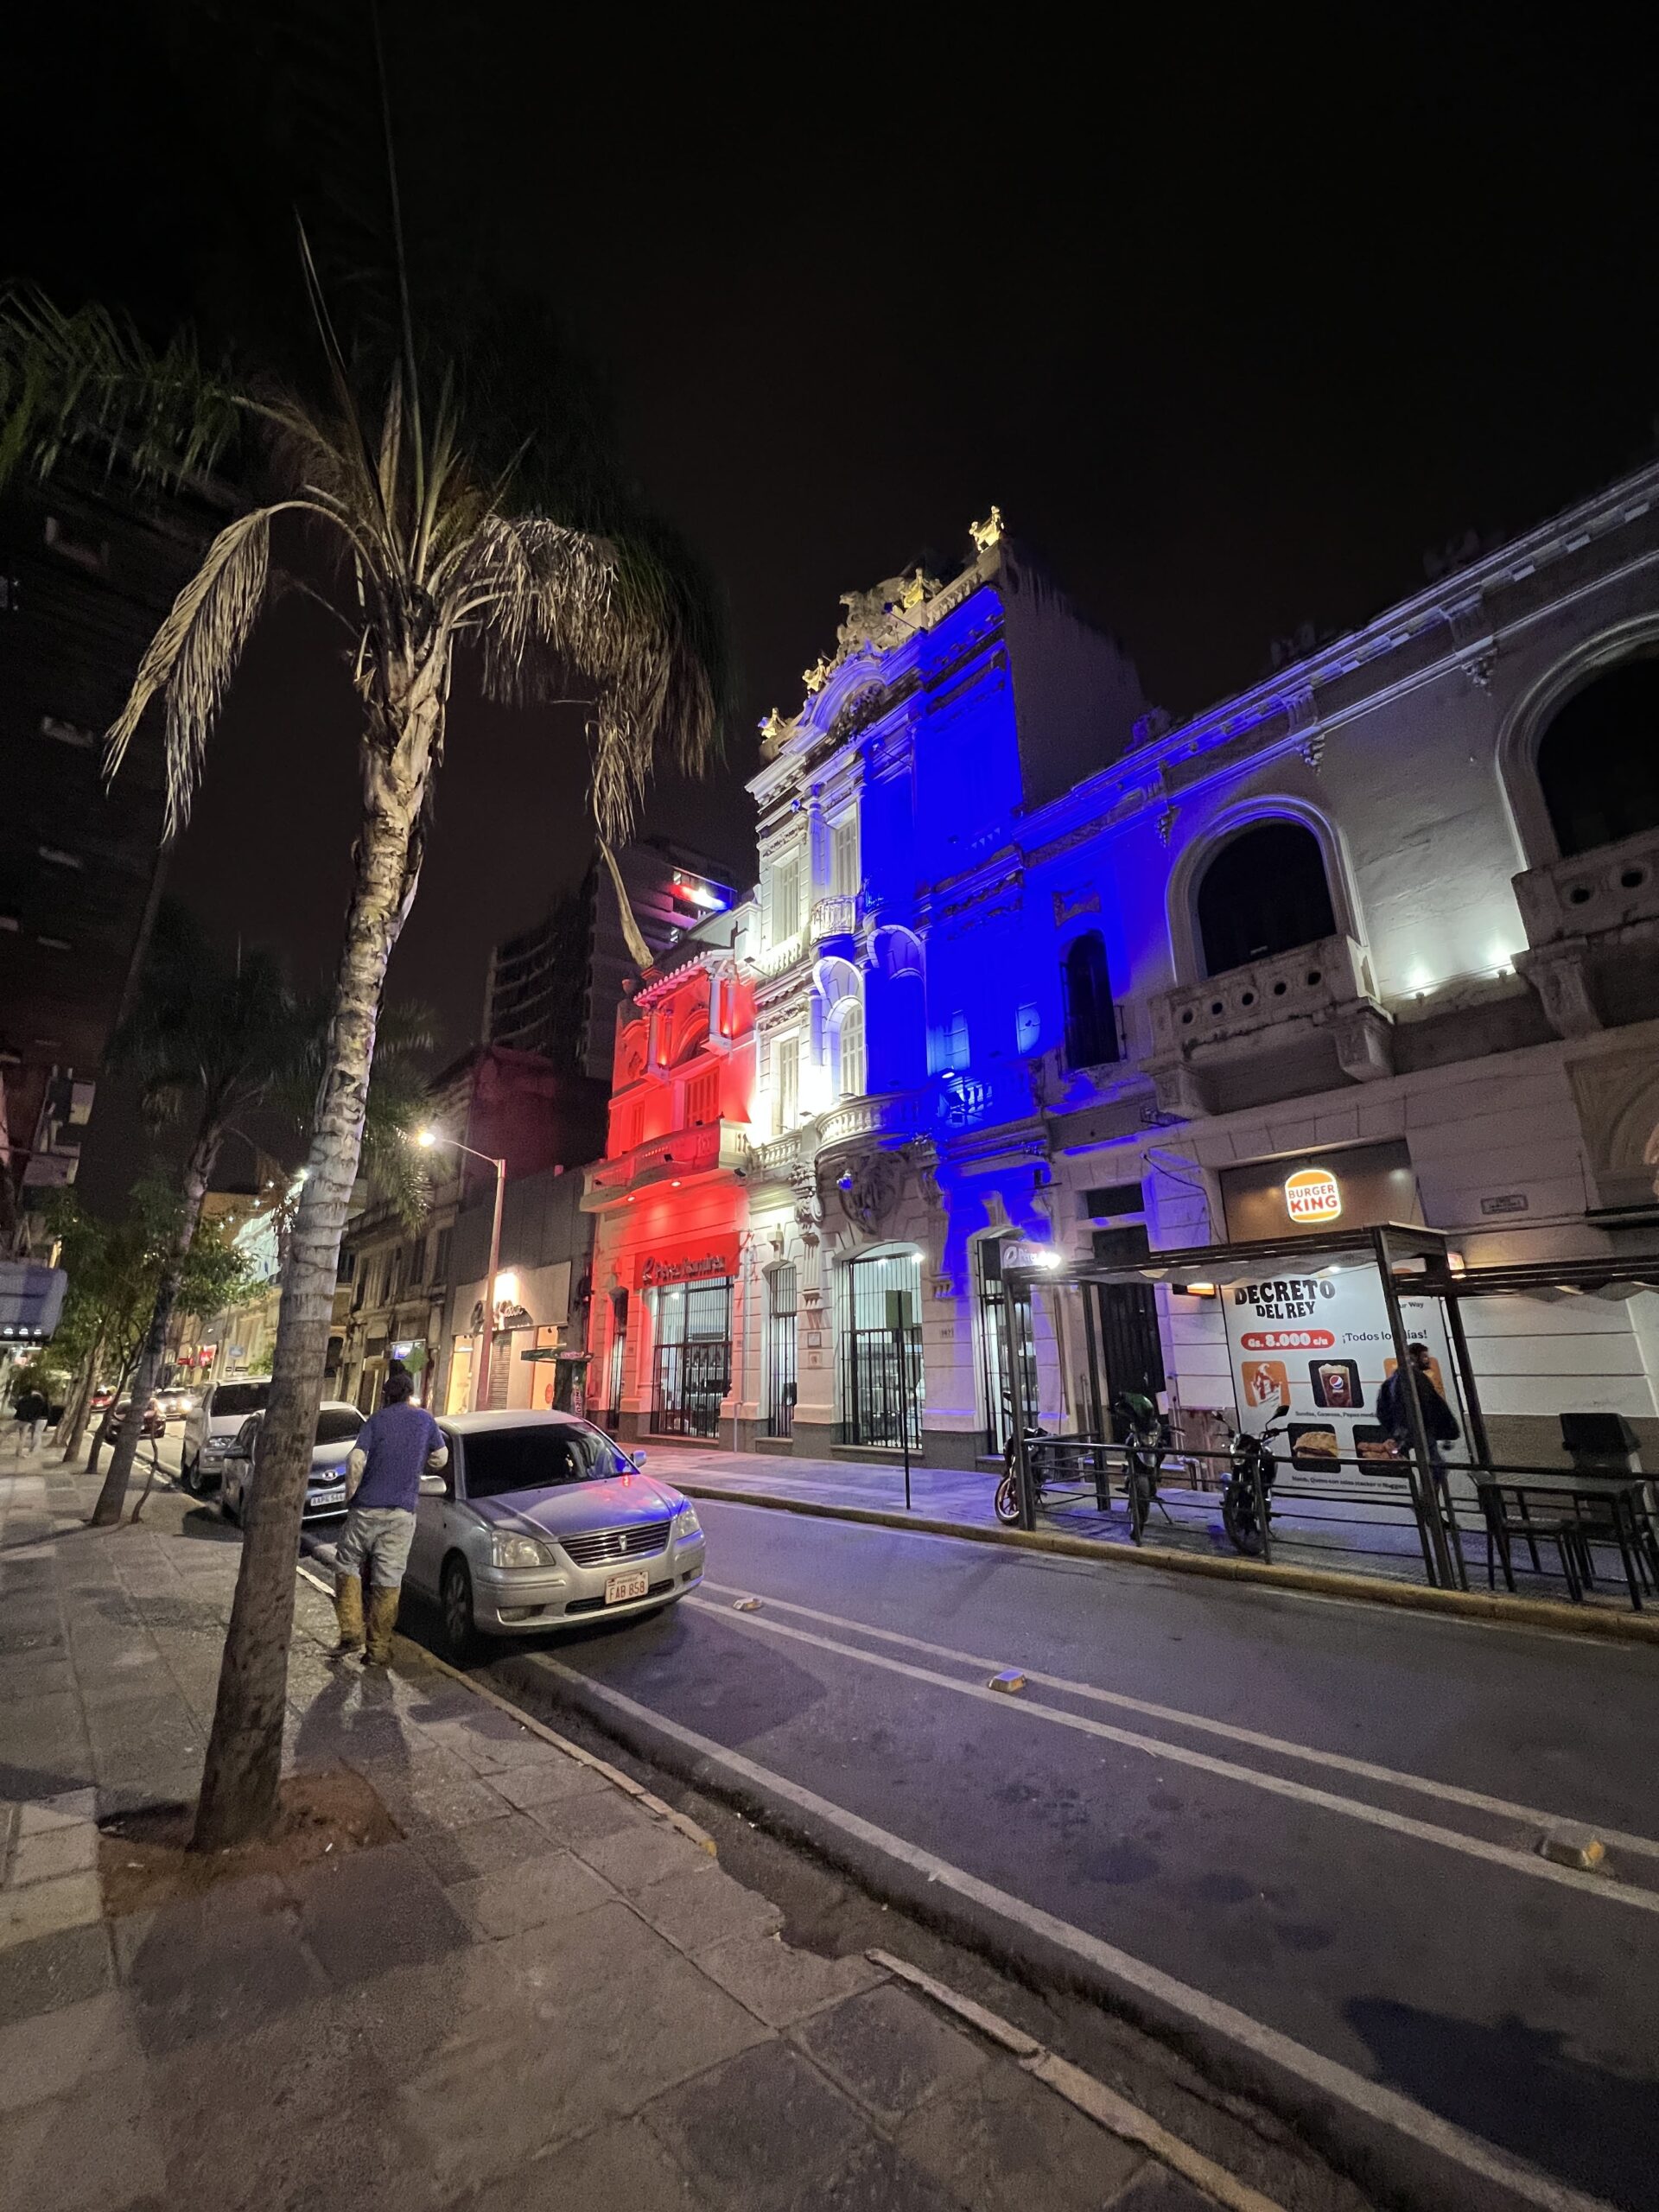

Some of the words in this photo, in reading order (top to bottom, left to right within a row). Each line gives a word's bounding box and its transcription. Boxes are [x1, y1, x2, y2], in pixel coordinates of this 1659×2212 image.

[1288, 1184, 1335, 1199] BURGER
[1290, 1195, 1338, 1213] KING
[1234, 1280, 1336, 1305] DECRETO
[1255, 1303, 1284, 1319] DEL
[1285, 1301, 1315, 1319] REY
[1265, 1332, 1312, 1347] 8.000
[1342, 1332, 1380, 1344] ¡Todos
[1381, 1331, 1391, 1341] lo
[1405, 1329, 1428, 1339] ías!
[610, 1586, 626, 1600] FAB
[629, 1581, 645, 1595] 858
